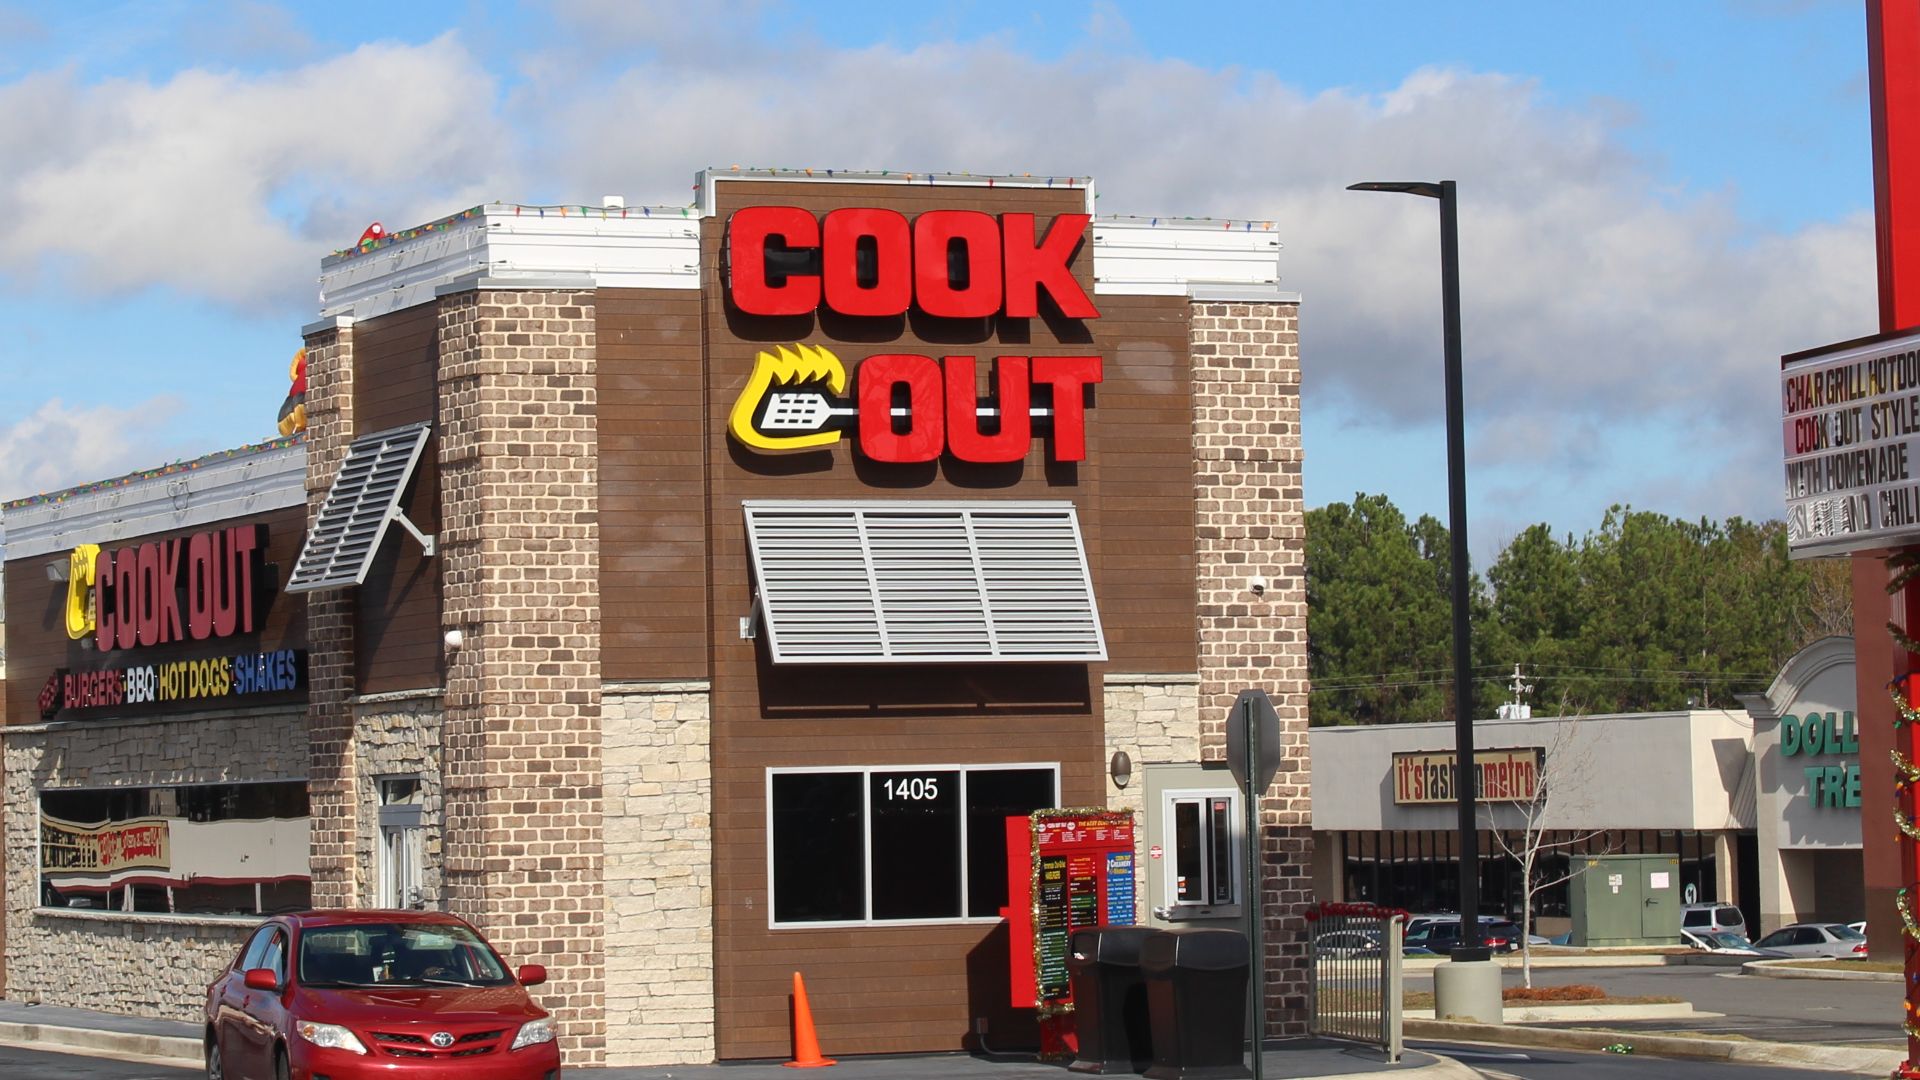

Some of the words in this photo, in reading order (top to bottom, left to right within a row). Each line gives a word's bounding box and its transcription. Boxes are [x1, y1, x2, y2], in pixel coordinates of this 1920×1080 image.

[729, 206, 1101, 319] COOK
[858, 354, 1103, 463] OUT
[1788, 372, 1823, 413] CHAR
[1826, 363, 1866, 404] GRILL
[1795, 412, 1829, 454] COOK
[1835, 409, 1862, 446] OUT
[1871, 395, 1919, 440] STYLE
[1787, 457, 1821, 498] WITH
[1826, 442, 1908, 491] HOMEMADE
[95, 539, 184, 651] COOK
[189, 525, 257, 640] OUT
[64, 669, 123, 709] BURGERS
[127, 665, 155, 703] BBQ
[159, 661, 187, 701] HOT
[189, 656, 230, 698] DOGS
[235, 650, 296, 695] SHAKES
[884, 778, 938, 800] 1405
